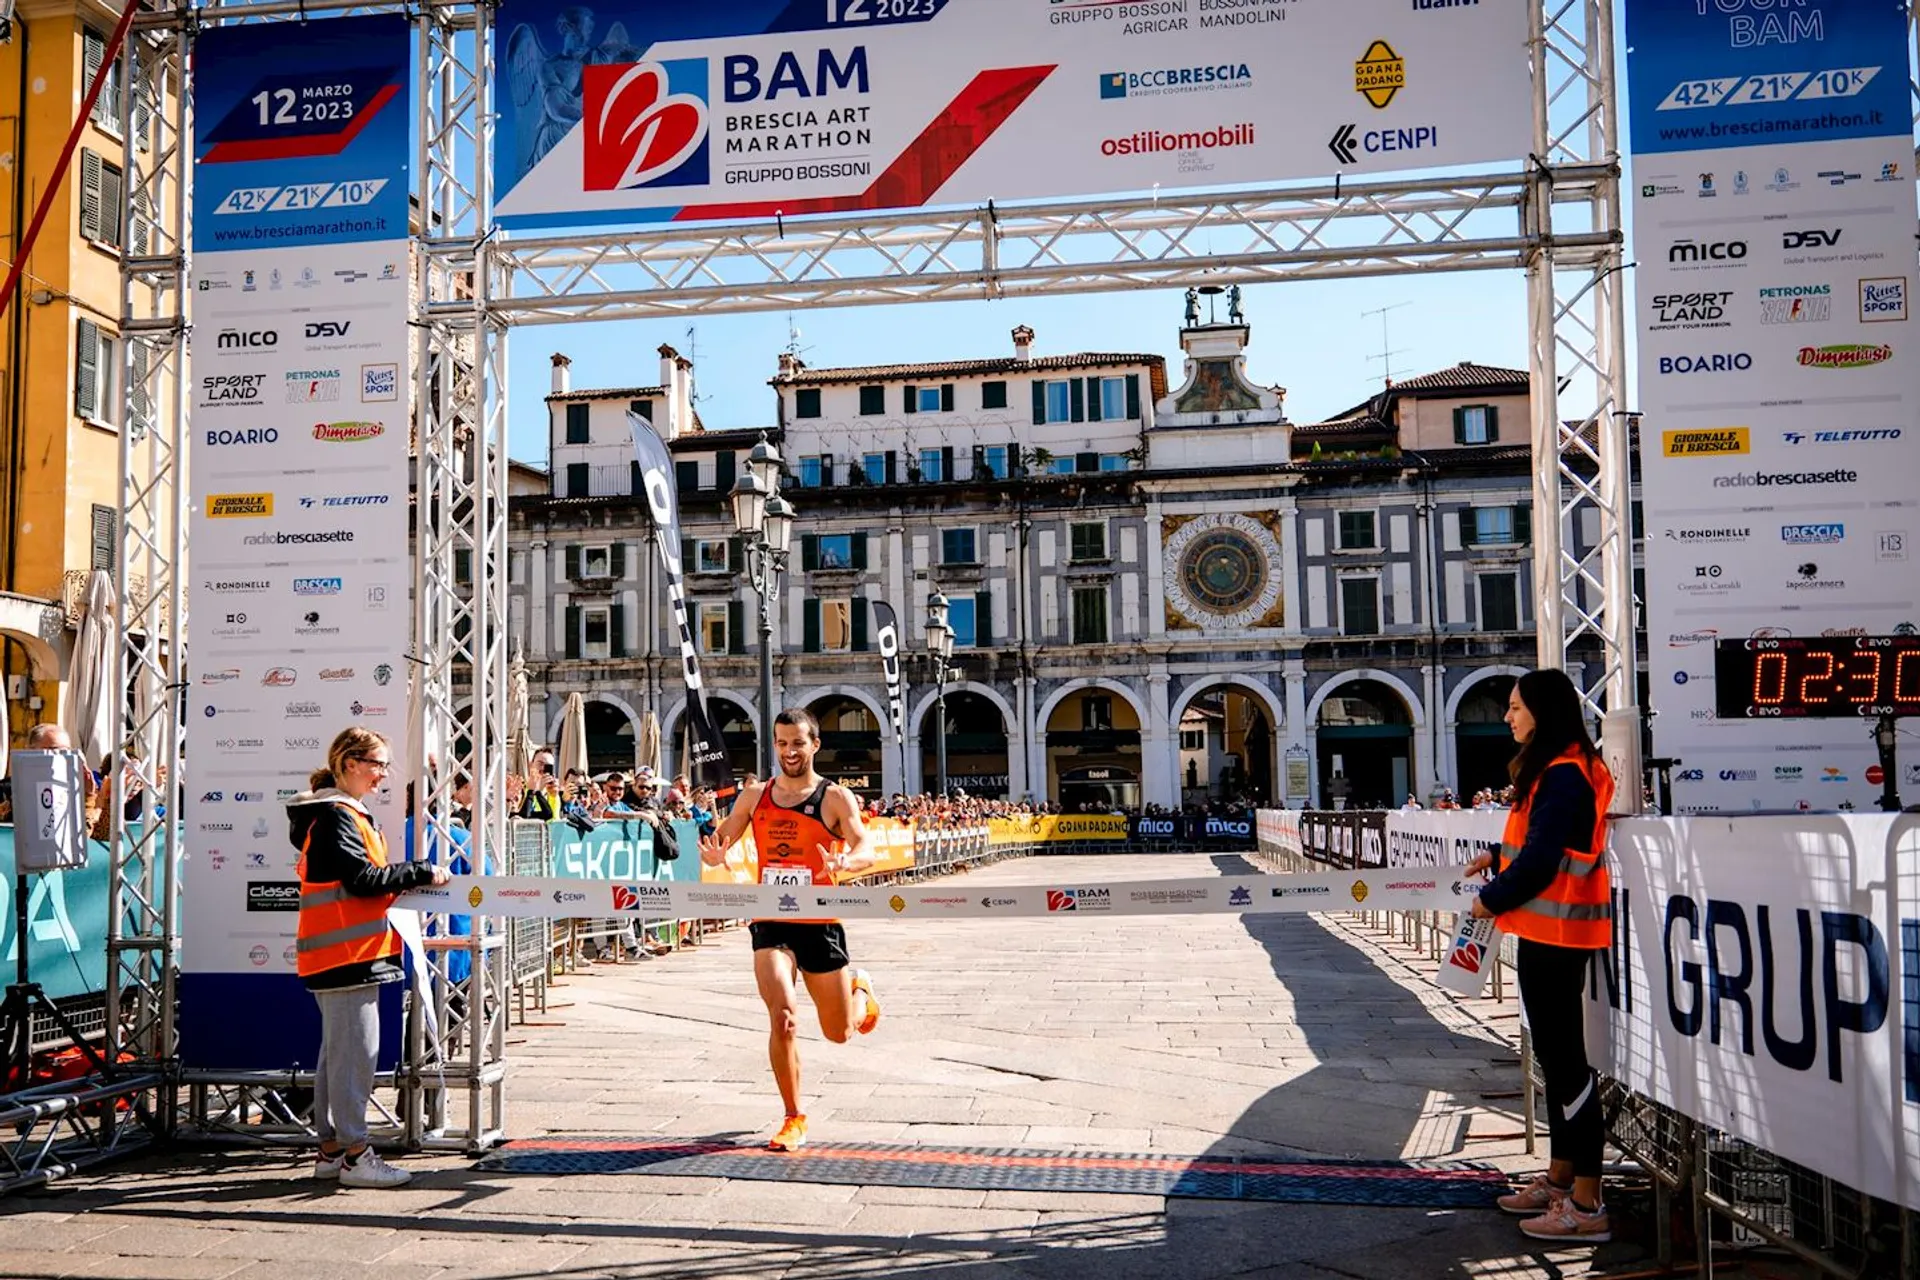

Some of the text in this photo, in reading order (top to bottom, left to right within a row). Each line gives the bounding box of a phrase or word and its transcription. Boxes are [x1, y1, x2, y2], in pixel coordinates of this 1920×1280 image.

[877, 0, 935, 18] 2023
[1050, 2, 1187, 25] GRUPPO BOSSONI
[1123, 18, 1188, 35] AGRICAR
[1201, 9, 1285, 28] MANDOLINI
[1730, 10, 1824, 48] BAM
[724, 45, 869, 103] BAM
[1129, 63, 1251, 88] BCCBRESCIA
[1355, 64, 1402, 75] GRANA
[1355, 74, 1403, 86] PADANO
[1674, 71, 1863, 105] 42K 21K 10K
[303, 84, 353, 98] MARZO
[1130, 88, 1162, 97] CREDITO
[1217, 81, 1252, 90] ITALIANO
[252, 88, 297, 126] 12
[303, 102, 354, 121] 2023
[726, 107, 871, 132] BRESCIA ART
[1660, 109, 1884, 141] www.bresciamarathon.it
[726, 129, 871, 154] MARATHON
[1101, 123, 1254, 156] ostiliomobili
[1363, 126, 1437, 153] CENPI
[725, 162, 870, 184] GRUPPO BOSSONI
[228, 182, 374, 211] 42K 21K 10K
[214, 217, 387, 242] www.bresciamarathon.it
[1783, 229, 1842, 249] DSV
[1759, 284, 1831, 298] PETRONAS
[1660, 306, 1723, 322] LAND
[1864, 300, 1903, 312] SPORT
[305, 321, 351, 338] DSV
[1659, 353, 1752, 375] BOARIO
[286, 370, 340, 380] PETRONAS
[208, 387, 258, 401] LAND
[365, 384, 395, 394] SPORT
[207, 428, 278, 446] BOARIO
[1674, 432, 1736, 443] GIORNALE
[1813, 429, 1901, 443] TELETUTTO
[1670, 441, 1741, 453] DI BRESCIA
[1713, 469, 1858, 488] radiobresciasette
[215, 496, 264, 506] GIORNALE
[322, 495, 389, 507] TELETUTTO
[212, 505, 266, 515] DI BRESCIA
[244, 530, 354, 546] radiobresciasette
[1680, 528, 1751, 539] RONDINELLE
[1784, 526, 1842, 539] BRESCIA
[216, 581, 270, 590] RONDINELLE
[1058, 821, 1087, 834] GRANA
[1089, 820, 1129, 833] PADANO
[640, 887, 670, 896] BAM
[1077, 888, 1110, 898] BAM
[1463, 884, 1480, 893] CEN
[563, 893, 586, 901] CENPI
